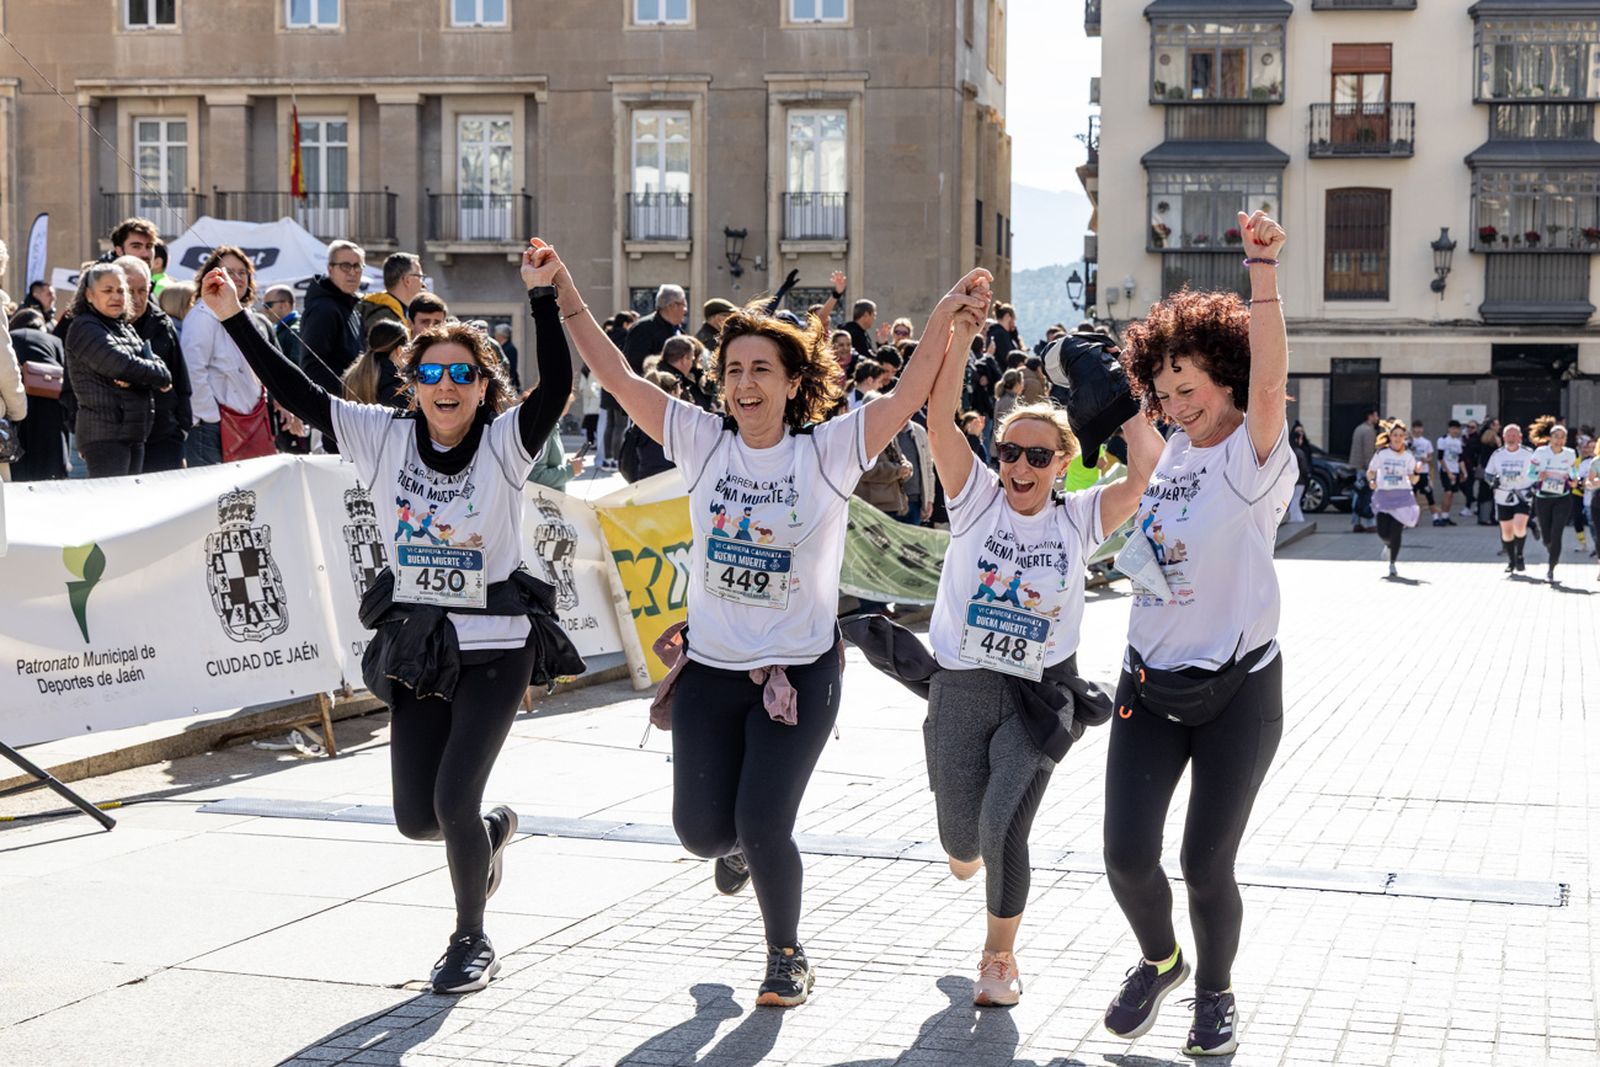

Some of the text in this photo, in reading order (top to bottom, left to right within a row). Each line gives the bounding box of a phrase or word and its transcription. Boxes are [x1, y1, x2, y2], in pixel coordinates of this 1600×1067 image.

[407, 555, 460, 567] BUENA MUERTE
[443, 549, 473, 557] CAMINATA
[714, 551, 767, 570] BUENA MUERTE
[722, 543, 750, 554] CARRERA
[751, 549, 782, 559] CAMINATA
[416, 568, 465, 592] 450
[720, 566, 770, 593] 449
[568, 618, 578, 631] DE
[976, 616, 1029, 636] BUENA MUERTE
[985, 608, 1012, 619] CARRERA
[1013, 614, 1042, 627] CAMINATA
[980, 631, 1027, 661] 448
[17, 645, 156, 675] Patronato Municipal de
[206, 641, 320, 677] CIUDAD DE JAÉN
[37, 666, 145, 696] Deportes de Jaén
